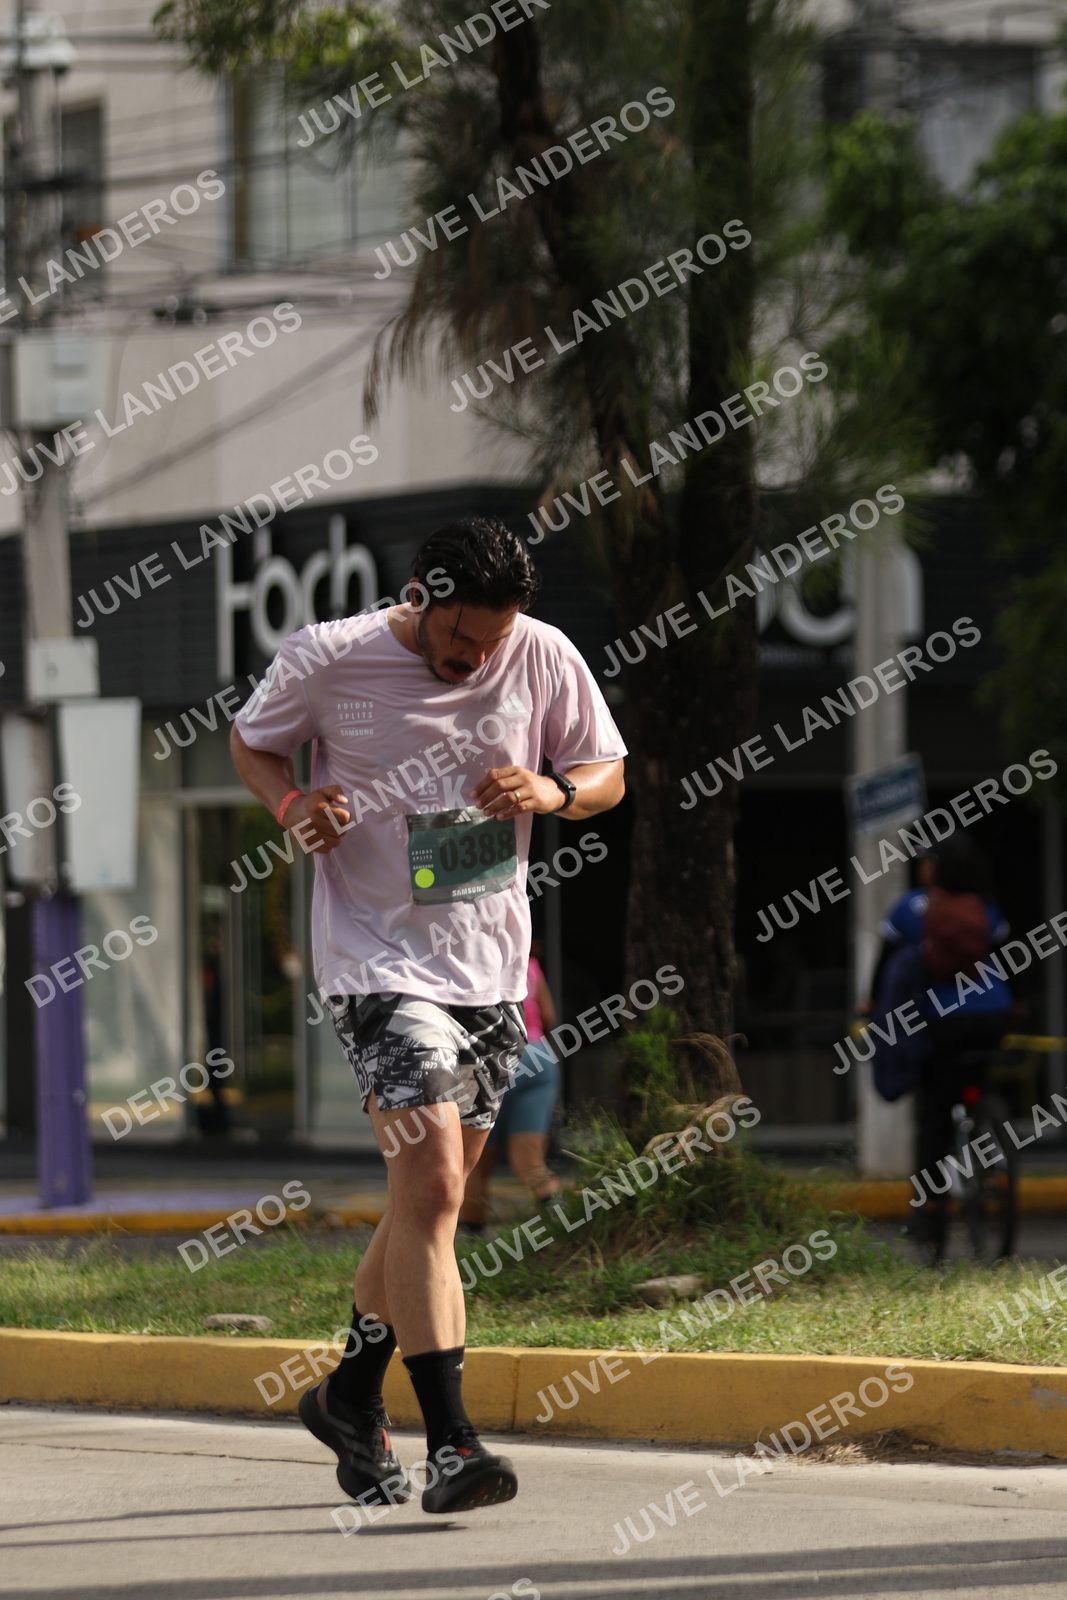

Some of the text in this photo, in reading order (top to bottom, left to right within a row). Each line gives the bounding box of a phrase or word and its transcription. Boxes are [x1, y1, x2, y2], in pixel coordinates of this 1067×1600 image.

[337, 701, 374, 710] ADIDAS
[339, 711, 373, 720] SPLITS
[340, 728, 374, 737] SAMSUNG
[442, 774, 468, 809] K
[440, 828, 514, 873] 0388
[452, 885, 486, 897] SAMSUNG
[389, 1046, 409, 1057] 1972
[378, 1056, 396, 1067] 1972
